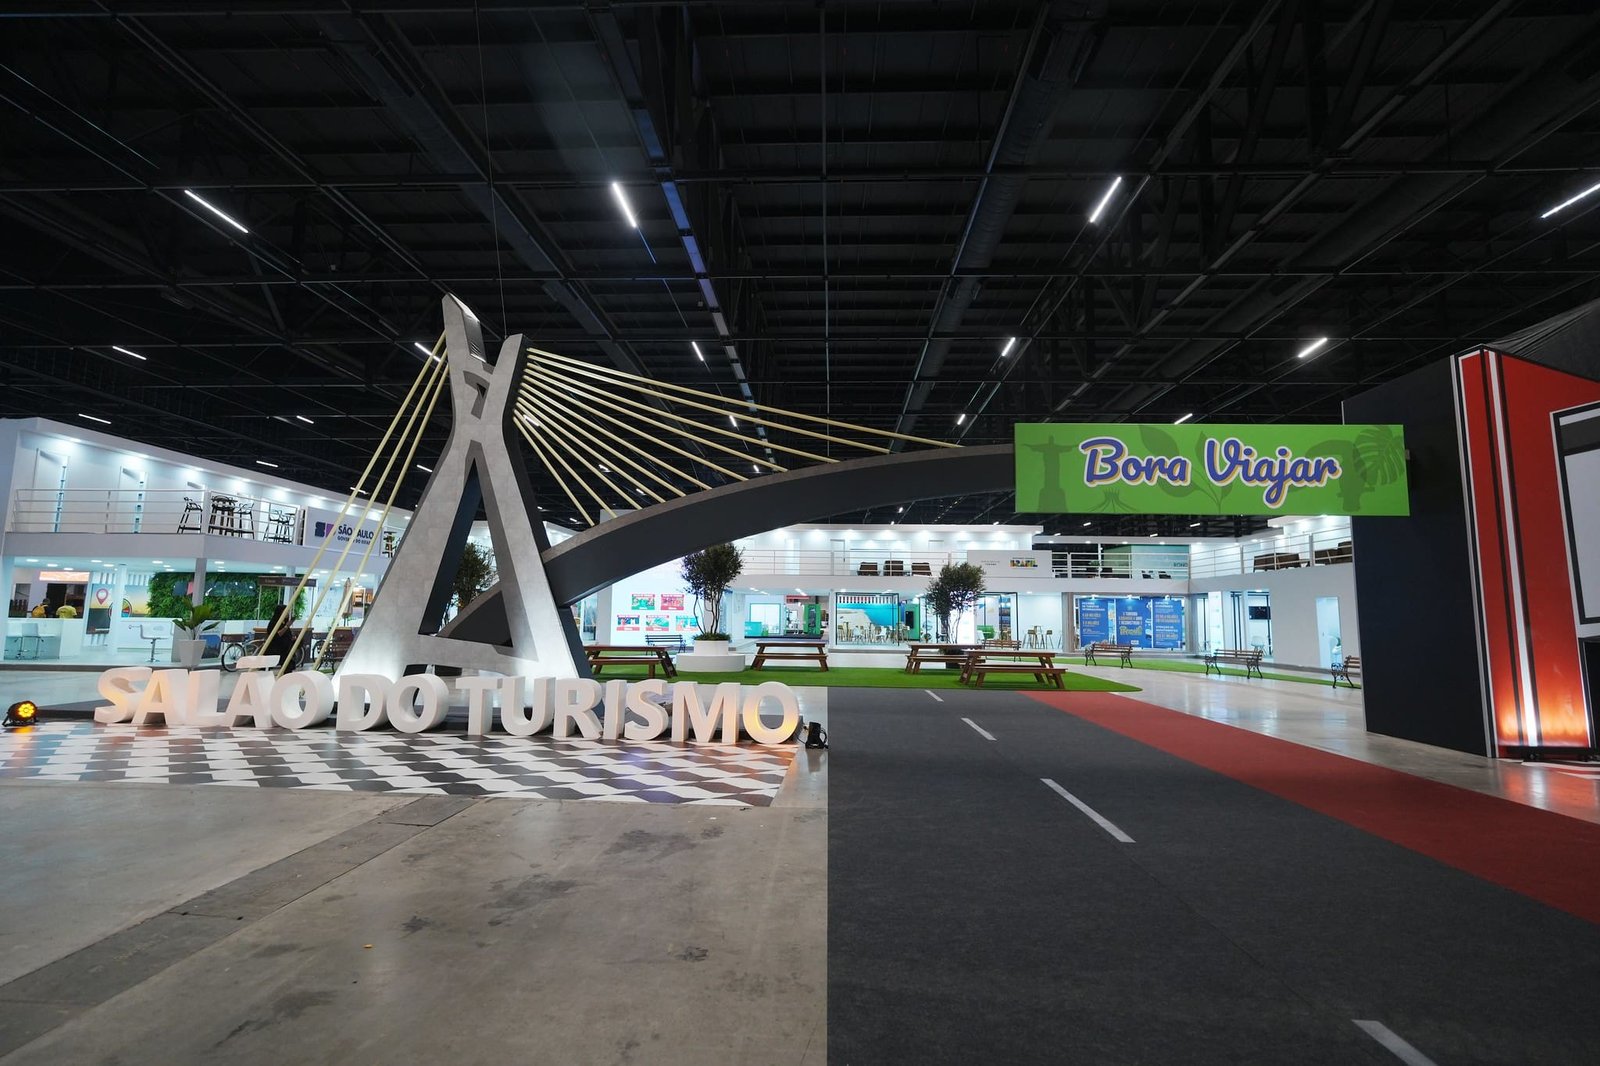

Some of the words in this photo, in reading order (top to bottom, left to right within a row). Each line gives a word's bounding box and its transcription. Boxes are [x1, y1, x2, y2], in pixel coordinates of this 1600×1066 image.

[1079, 436, 1191, 488] Bora
[1203, 437, 1342, 509] Viajar
[338, 524, 352, 536] SÃO
[354, 528, 374, 539] AULO
[94, 655, 334, 730] SALÃO
[336, 673, 449, 734] DO
[455, 676, 799, 745] TURISMO
